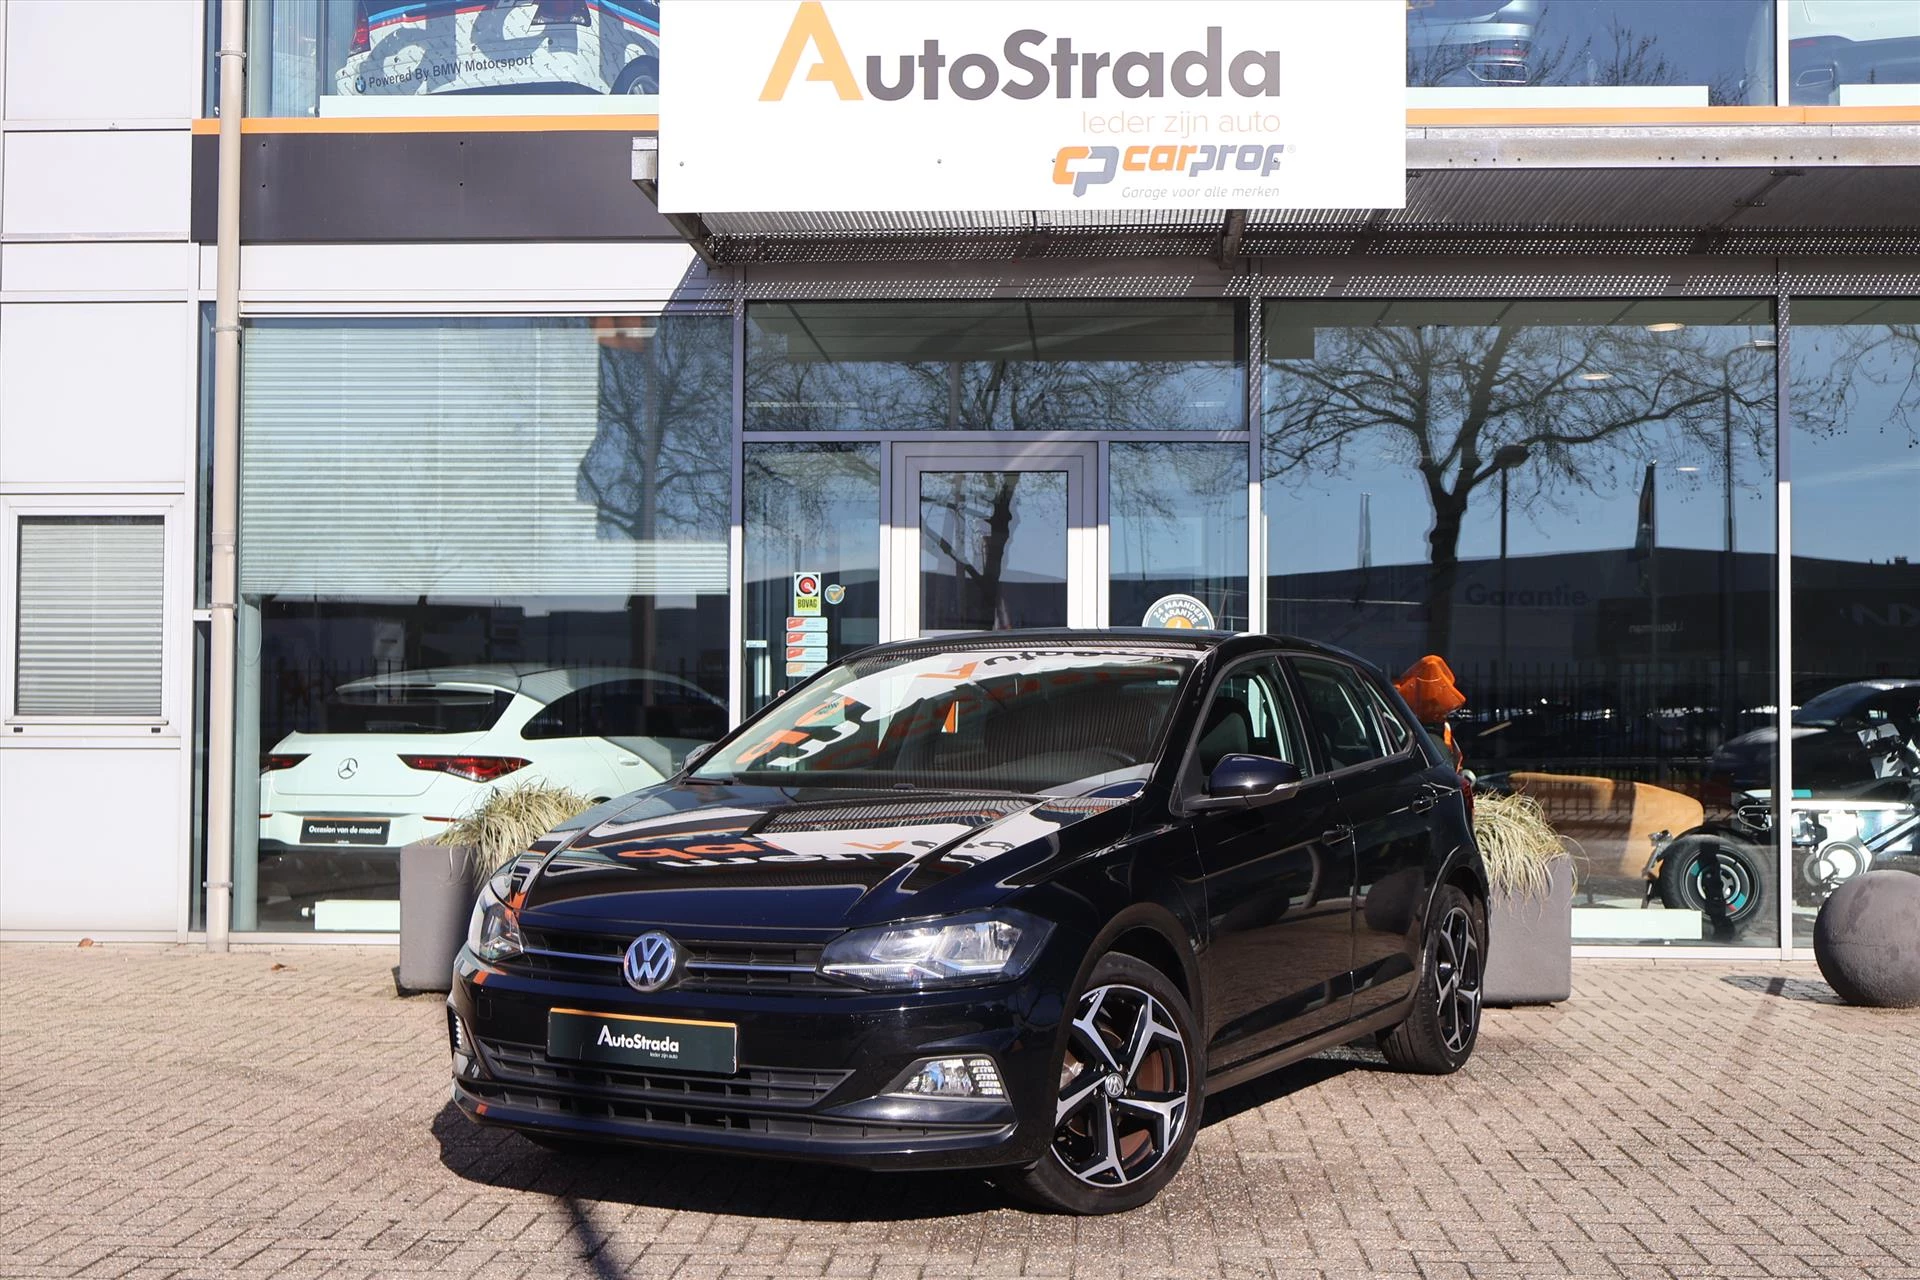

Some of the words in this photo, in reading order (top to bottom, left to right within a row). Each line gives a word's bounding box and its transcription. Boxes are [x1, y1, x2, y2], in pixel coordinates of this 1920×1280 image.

[758, 1, 1280, 102] AutoStrada
[368, 71, 412, 88] Powered
[415, 67, 429, 81] By
[432, 61, 462, 77] BMW
[465, 54, 534, 73] Motorsport
[1083, 111, 1154, 133] Ieder
[1164, 111, 1208, 139] zijn
[1219, 111, 1280, 133] auto
[1122, 144, 1285, 177] carprof
[1121, 186, 1167, 200] Garage
[1172, 187, 1200, 198] voor
[1204, 186, 1228, 198] alle
[1231, 186, 1280, 198] merken
[797, 599, 818, 609] BOVAG
[1464, 580, 1588, 606] Garantie
[1153, 607, 1165, 618] 24
[1164, 600, 1205, 620] MAANDEN
[1160, 608, 1200, 625] GARANTIE
[308, 825, 336, 834] Occasion
[349, 825, 358, 834] de
[358, 825, 382, 834] maand
[597, 1025, 680, 1053] AutoStrada
